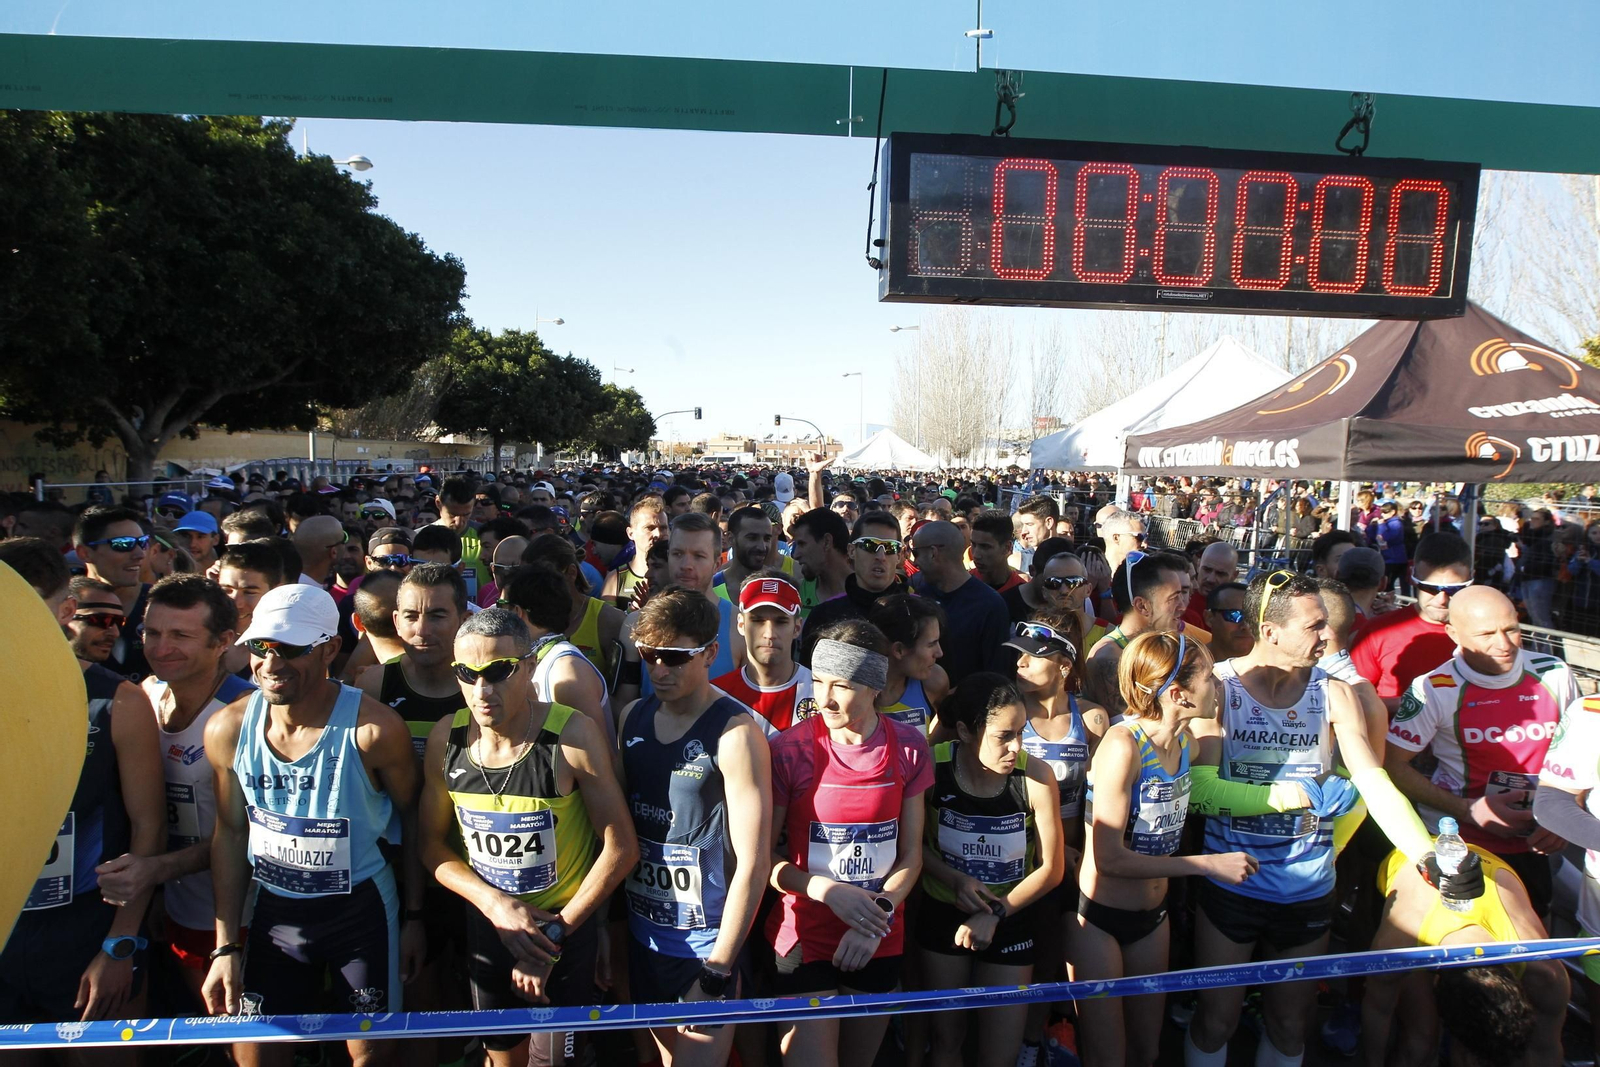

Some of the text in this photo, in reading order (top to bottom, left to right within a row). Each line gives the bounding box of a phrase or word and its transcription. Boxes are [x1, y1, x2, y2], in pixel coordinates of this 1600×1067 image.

[1232, 729, 1320, 747] MARACENA
[1174, 800, 1180, 811] 6
[520, 814, 544, 822] MEDIO
[634, 801, 676, 823] DEHARO
[510, 820, 545, 829] MARATÓN
[1001, 817, 1020, 825] MEDIO
[878, 824, 895, 832] MEDIO
[291, 838, 297, 848] 1
[471, 831, 545, 858] 1024
[977, 835, 986, 844] 4
[277, 845, 334, 866] MOUAZIZ
[853, 845, 862, 857] 8
[962, 843, 1002, 858] BENALI
[489, 856, 523, 865] ZOUHAIR
[839, 857, 875, 875] OCHAL
[632, 861, 691, 892] 2300
[645, 886, 669, 898] SERGIO
